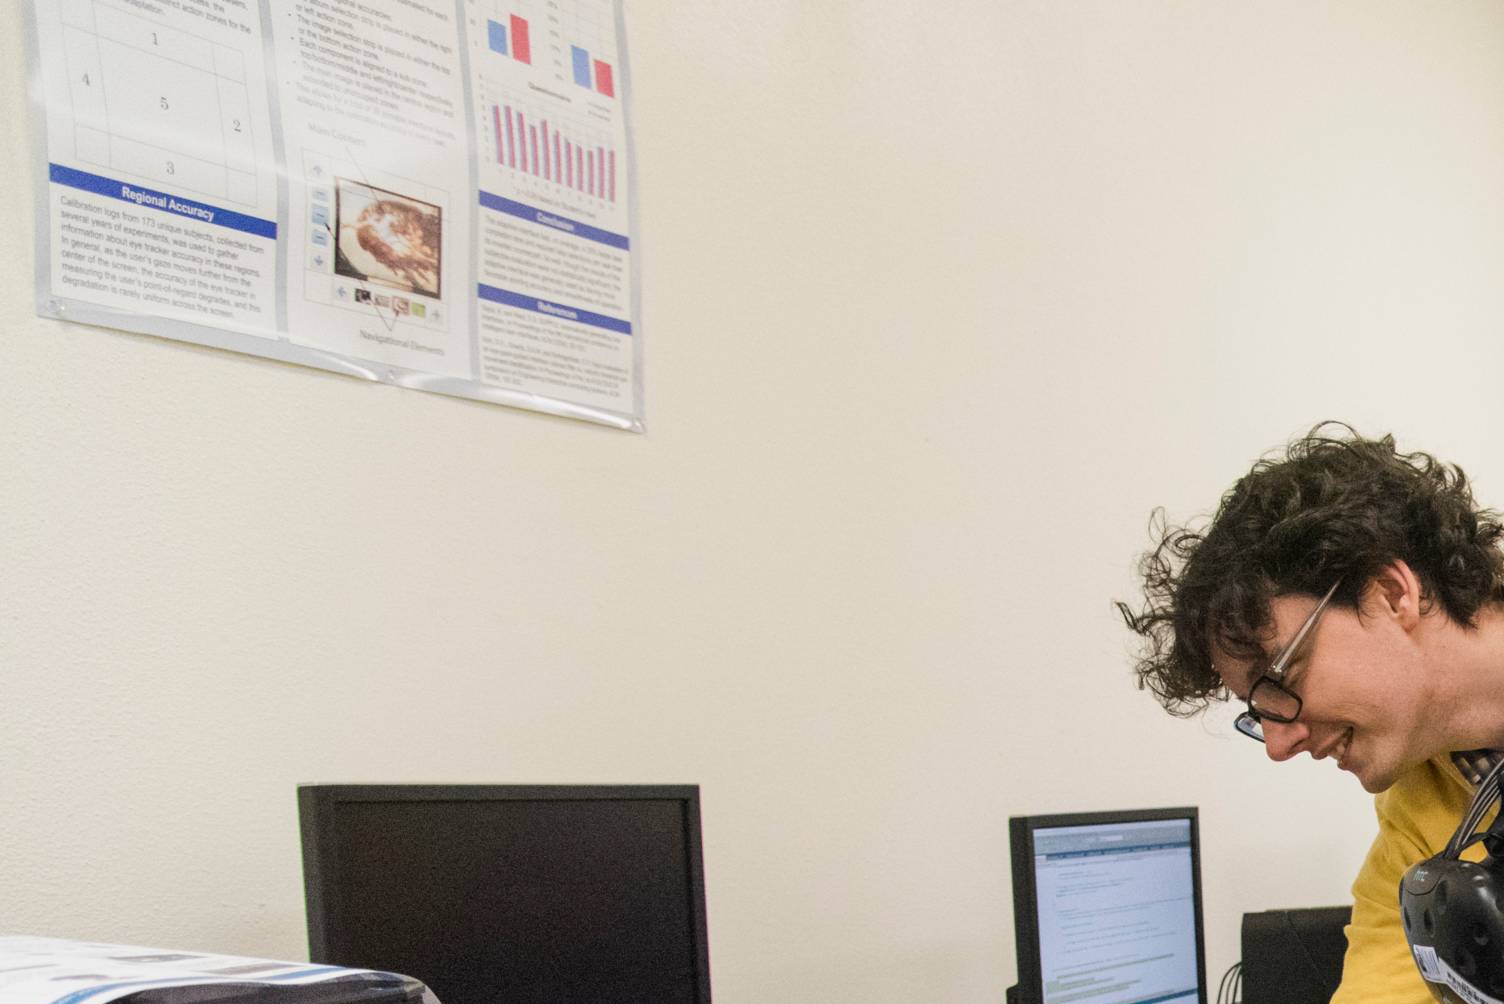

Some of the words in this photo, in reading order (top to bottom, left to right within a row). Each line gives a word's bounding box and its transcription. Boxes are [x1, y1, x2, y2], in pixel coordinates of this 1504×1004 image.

[152, 32, 158, 46] 1
[82, 73, 90, 86] 4
[160, 96, 169, 110] 5
[233, 119, 241, 132] 2
[166, 161, 175, 175] 3
[122, 186, 167, 208] Regional
[168, 197, 215, 222] Accuracy
[122, 211, 139, 223] from
[141, 216, 155, 227] 173
